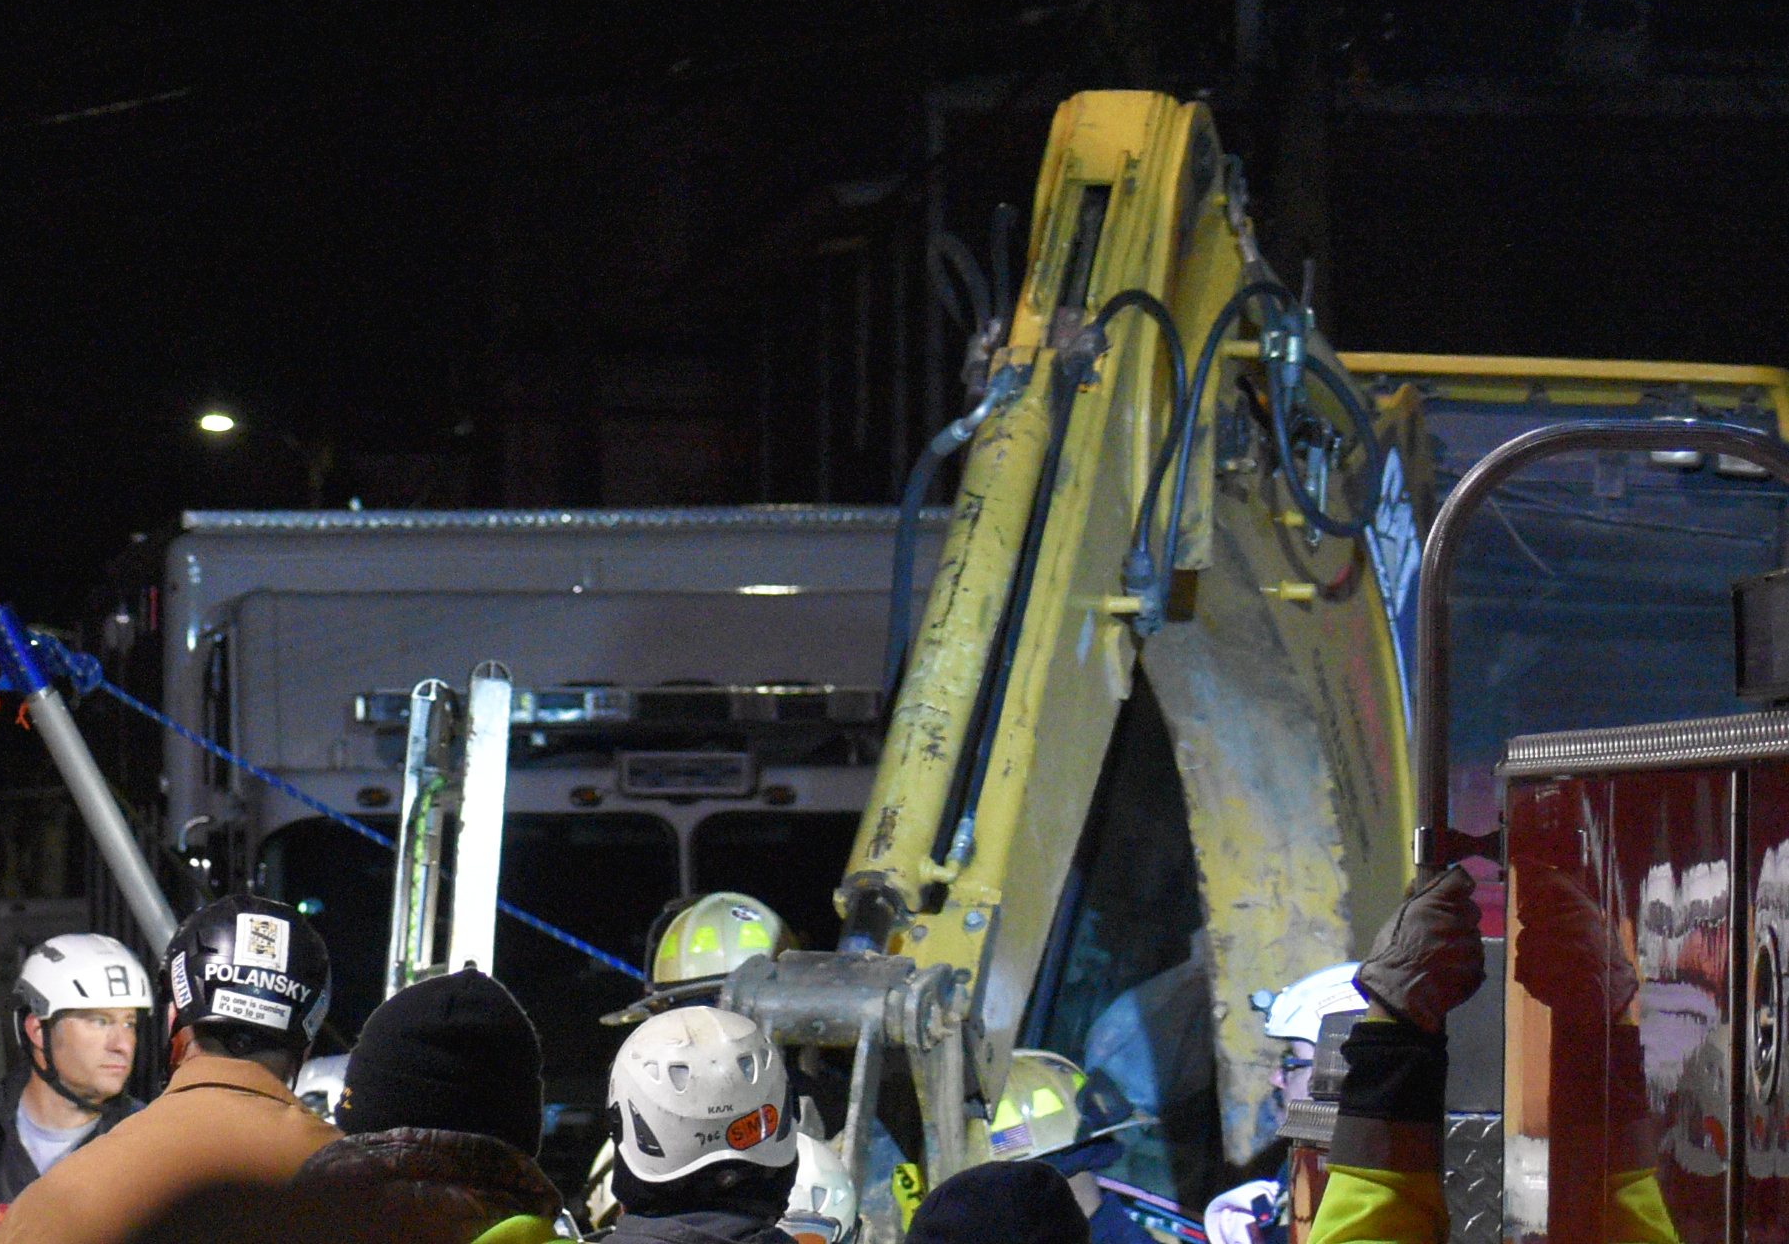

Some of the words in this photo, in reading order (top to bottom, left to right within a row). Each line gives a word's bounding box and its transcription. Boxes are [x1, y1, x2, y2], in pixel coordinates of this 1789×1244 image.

[175, 955, 191, 1004] IRWIN
[205, 963, 312, 1003] POLANSKY
[233, 997, 247, 1006] one
[233, 1007, 243, 1015] up
